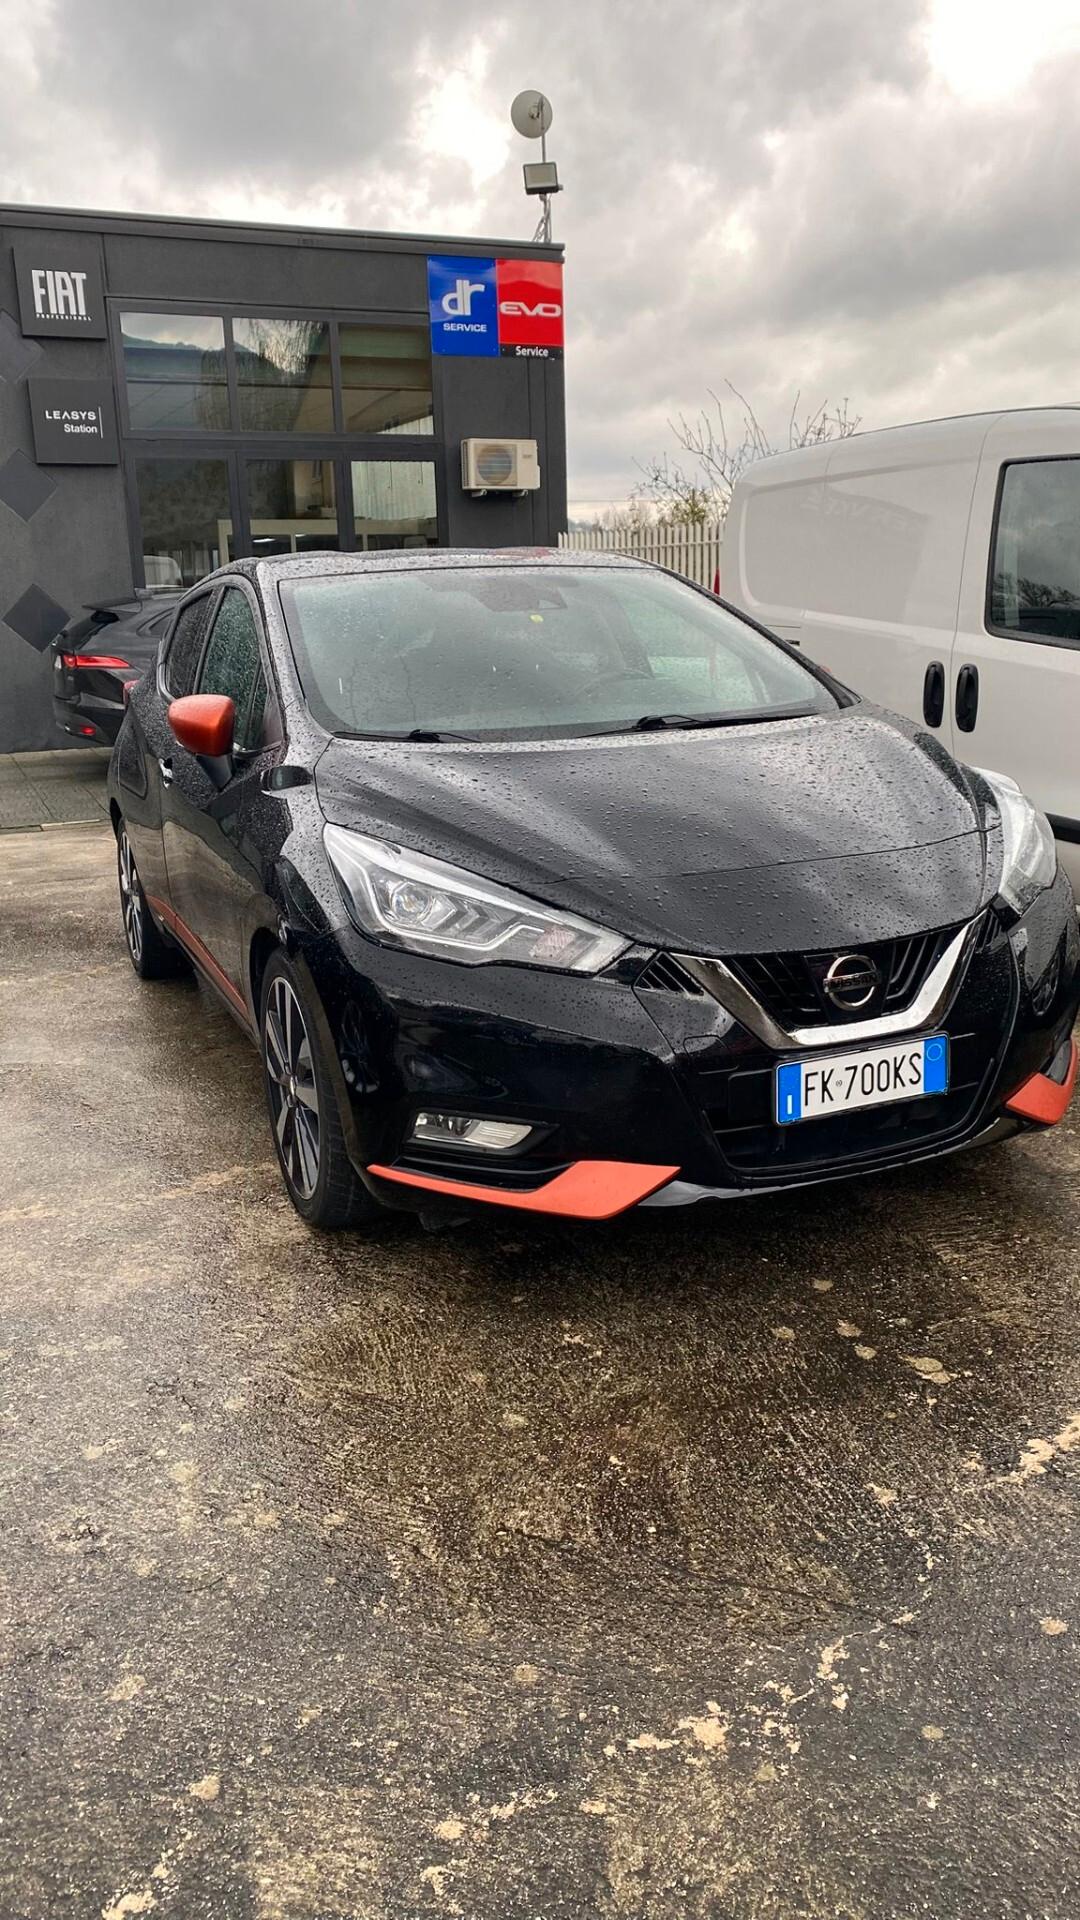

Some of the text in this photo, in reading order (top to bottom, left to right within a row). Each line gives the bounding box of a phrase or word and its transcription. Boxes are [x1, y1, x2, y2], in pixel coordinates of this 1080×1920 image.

[32, 269, 87, 315] FIAT
[442, 279, 485, 316] dr
[500, 301, 562, 318] EVO
[443, 322, 488, 333] SERVICE
[515, 345, 549, 357] Service
[45, 410, 96, 420] LEASYS
[64, 423, 98, 434] Station
